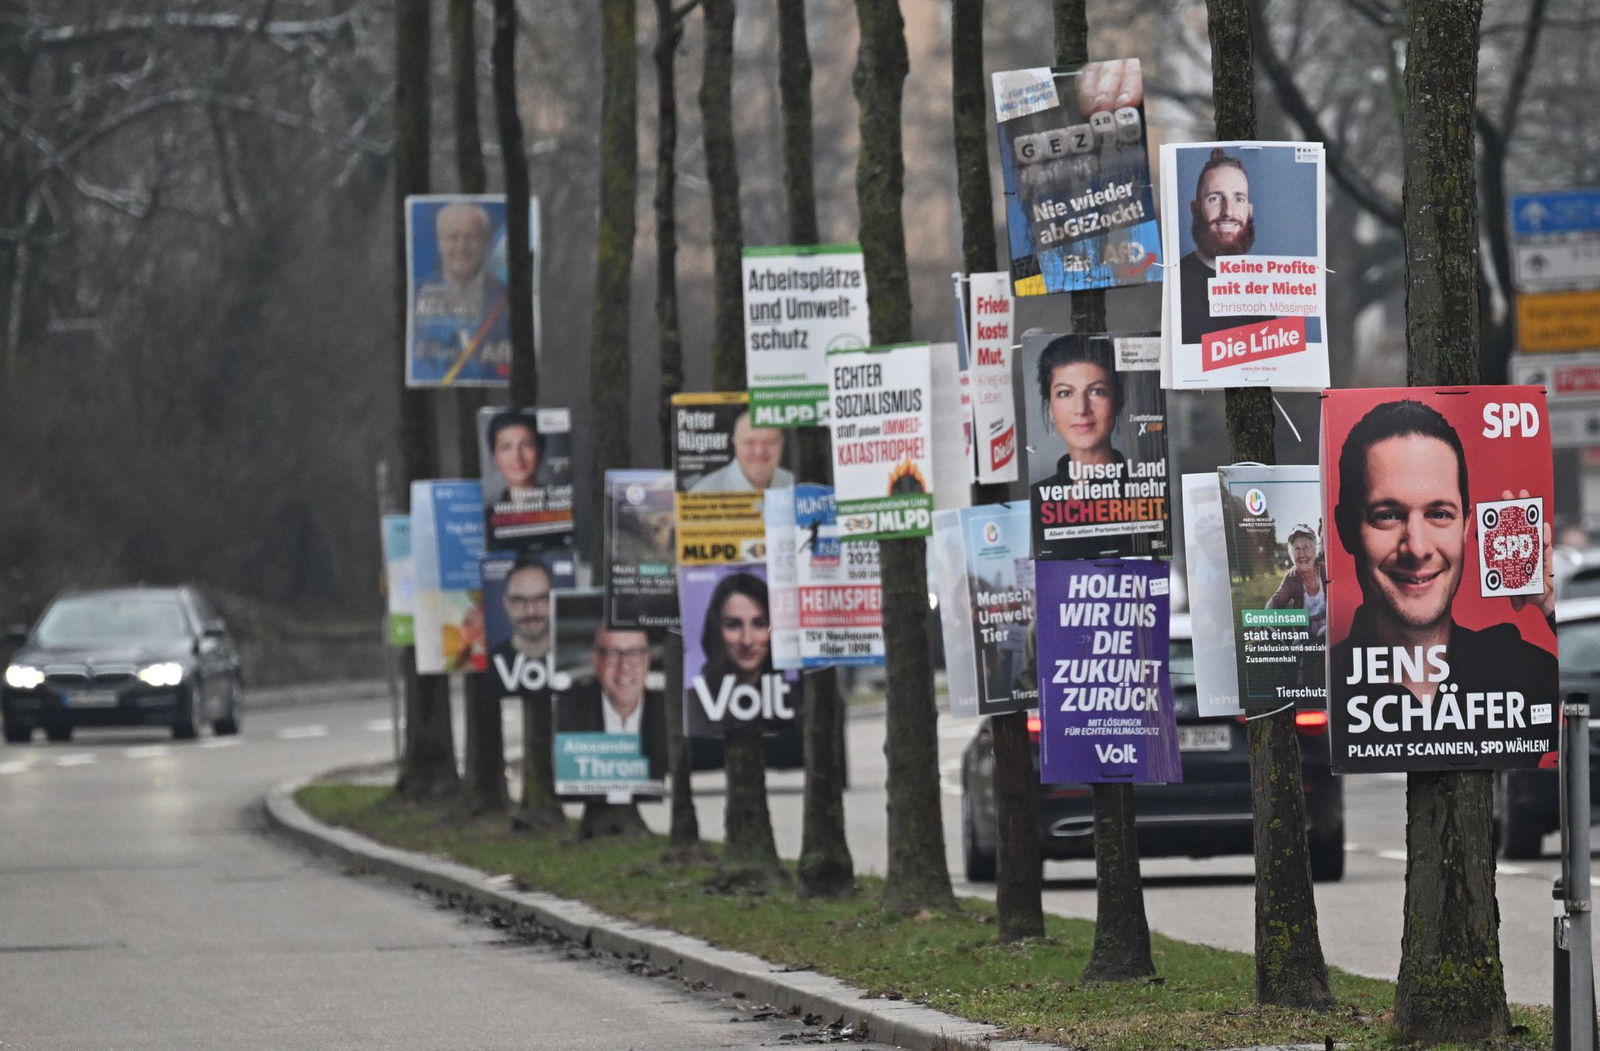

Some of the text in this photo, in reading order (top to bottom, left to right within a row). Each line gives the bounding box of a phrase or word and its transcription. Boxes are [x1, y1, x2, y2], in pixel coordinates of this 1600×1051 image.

[1033, 181, 1133, 222] Nie wieder
[1040, 200, 1145, 244] abGEZockt!
[1220, 259, 1316, 274] Keine Profite
[748, 266, 861, 292] Arbeitsplätze
[1212, 281, 1316, 295] mit der Miete!
[749, 296, 858, 321] und Umwelt-
[1212, 302, 1267, 314] Christoph
[751, 328, 809, 351] schutz
[1211, 326, 1299, 362] Die Linke
[977, 348, 1005, 367] Mut,
[834, 363, 882, 390] ECHTER
[755, 405, 815, 425] MLPD
[835, 388, 922, 419] SOZIALISMUS
[836, 423, 856, 438] statt
[882, 417, 923, 436] UMWELT-
[1482, 403, 1540, 439] SPD
[838, 437, 925, 466] KATASTROPHE!
[1068, 458, 1166, 480] Unser Land
[1039, 478, 1167, 501] verdient mehr
[879, 508, 930, 532] MLPD
[1040, 498, 1168, 524] SICHERHEIT.
[682, 543, 737, 560] MLPD
[1492, 534, 1532, 560] SPD
[977, 587, 1032, 606] Mensch
[1068, 575, 1147, 598] HOLEN
[978, 606, 1034, 625] Umwelt
[1060, 603, 1156, 627] WIR UNS
[1245, 612, 1306, 623] Gemeinsam
[980, 628, 1010, 643] Tier
[1092, 631, 1133, 654] DIE
[1244, 629, 1309, 640] statt einsam
[1244, 644, 1256, 652] Für
[1258, 644, 1289, 652] Inklusion
[1052, 659, 1162, 683] ZUKUNFT
[1346, 645, 1450, 685] JENS
[692, 673, 795, 721] Volt
[1060, 683, 1159, 711] ZURÜCK
[1346, 683, 1526, 734] SCHÄFER
[1065, 726, 1160, 735] FÜR ECHTEN KLIMASCHUTZ
[1103, 717, 1141, 726] LÖSUNGEN
[1095, 744, 1138, 763] Volt
[1348, 738, 1550, 757] PLAKAT SCANNEN, SPD WÄHLEN!
